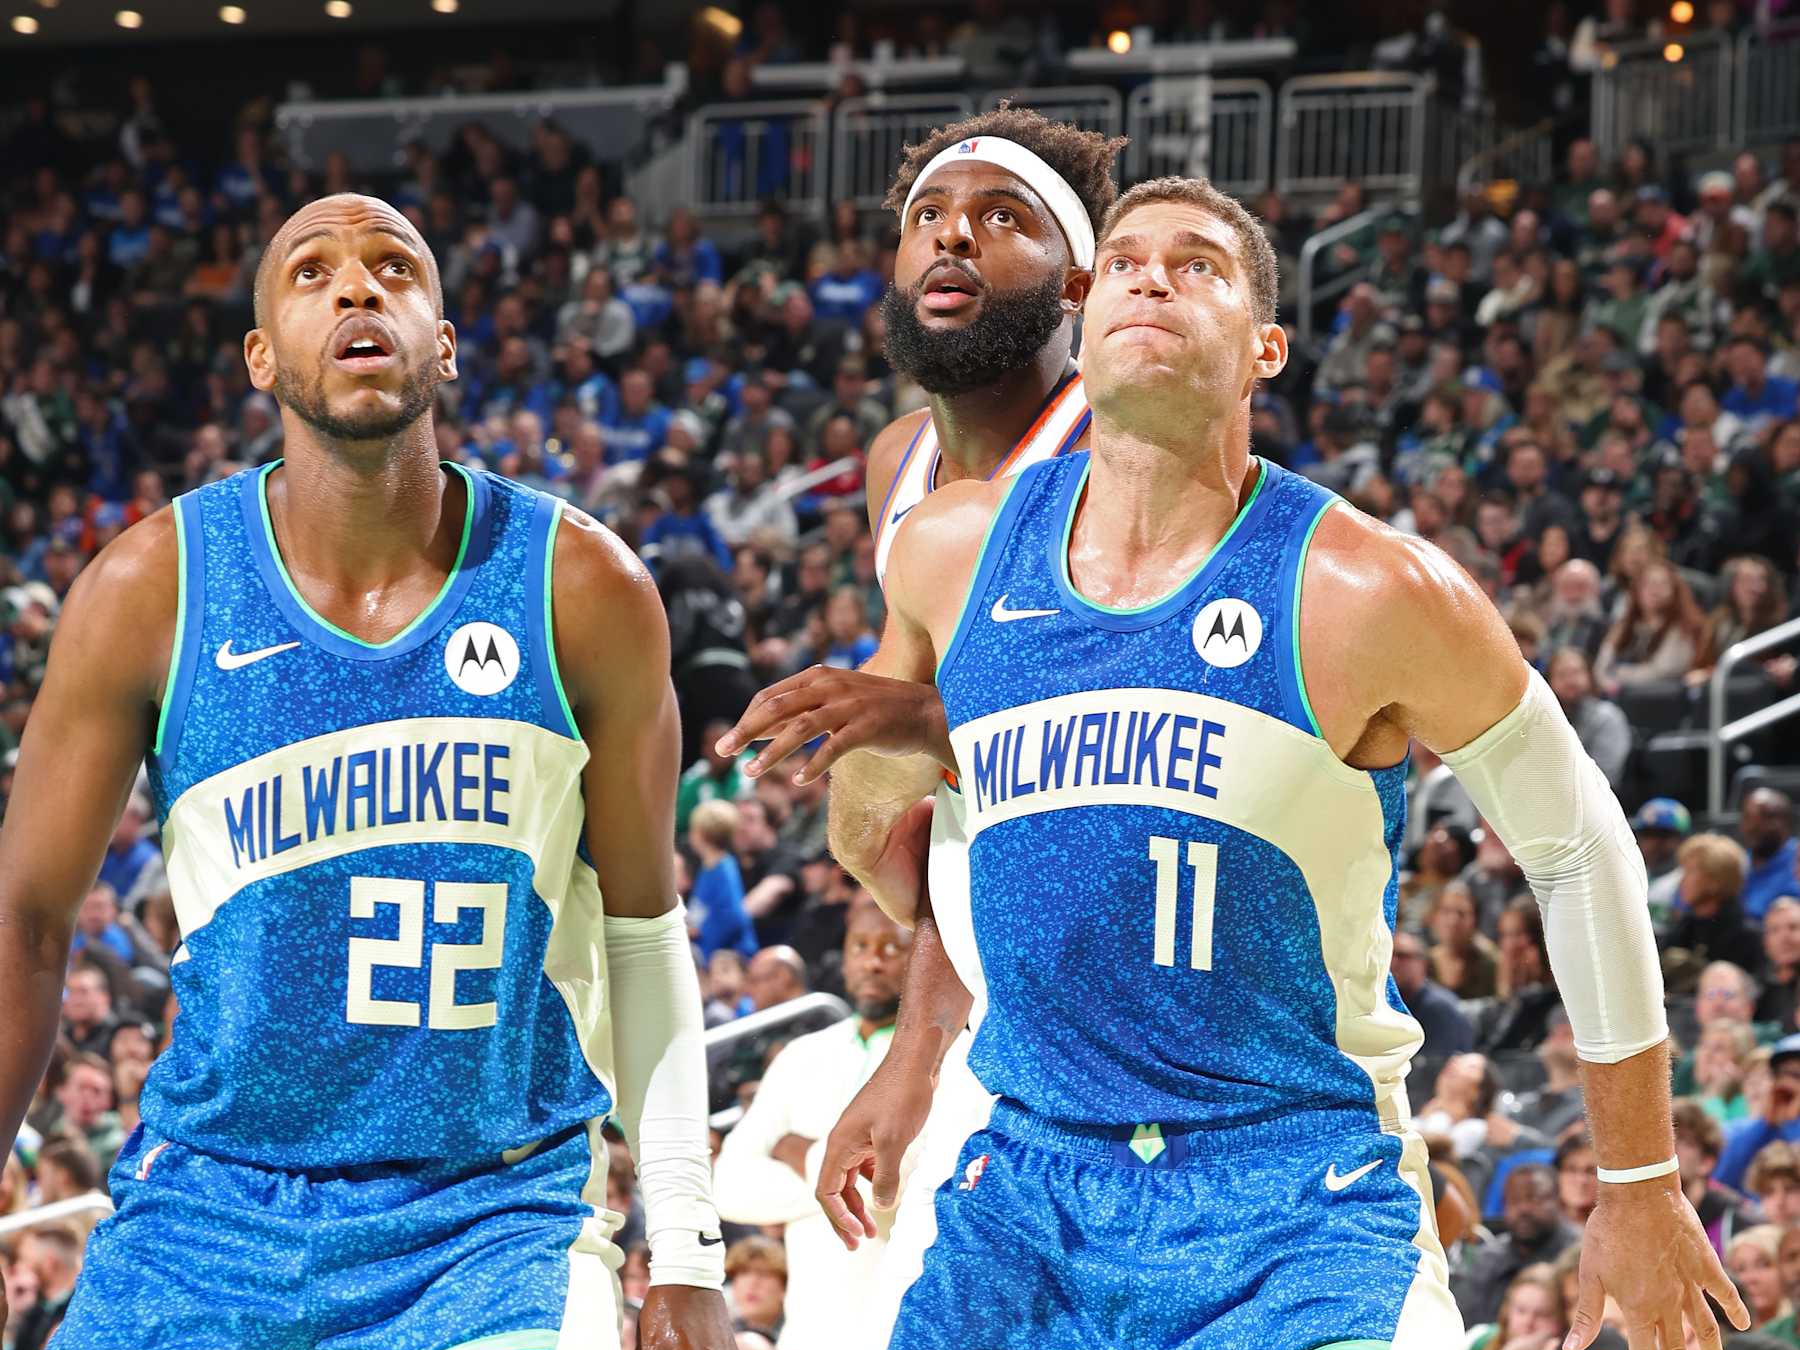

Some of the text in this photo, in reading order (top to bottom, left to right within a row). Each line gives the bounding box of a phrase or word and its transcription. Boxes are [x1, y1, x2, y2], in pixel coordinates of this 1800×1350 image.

[223, 742, 511, 869] MILWAUKEE
[973, 711, 1226, 813] MILWAUKEE
[346, 876, 509, 1030] 22
[1148, 835, 1219, 972] 11
